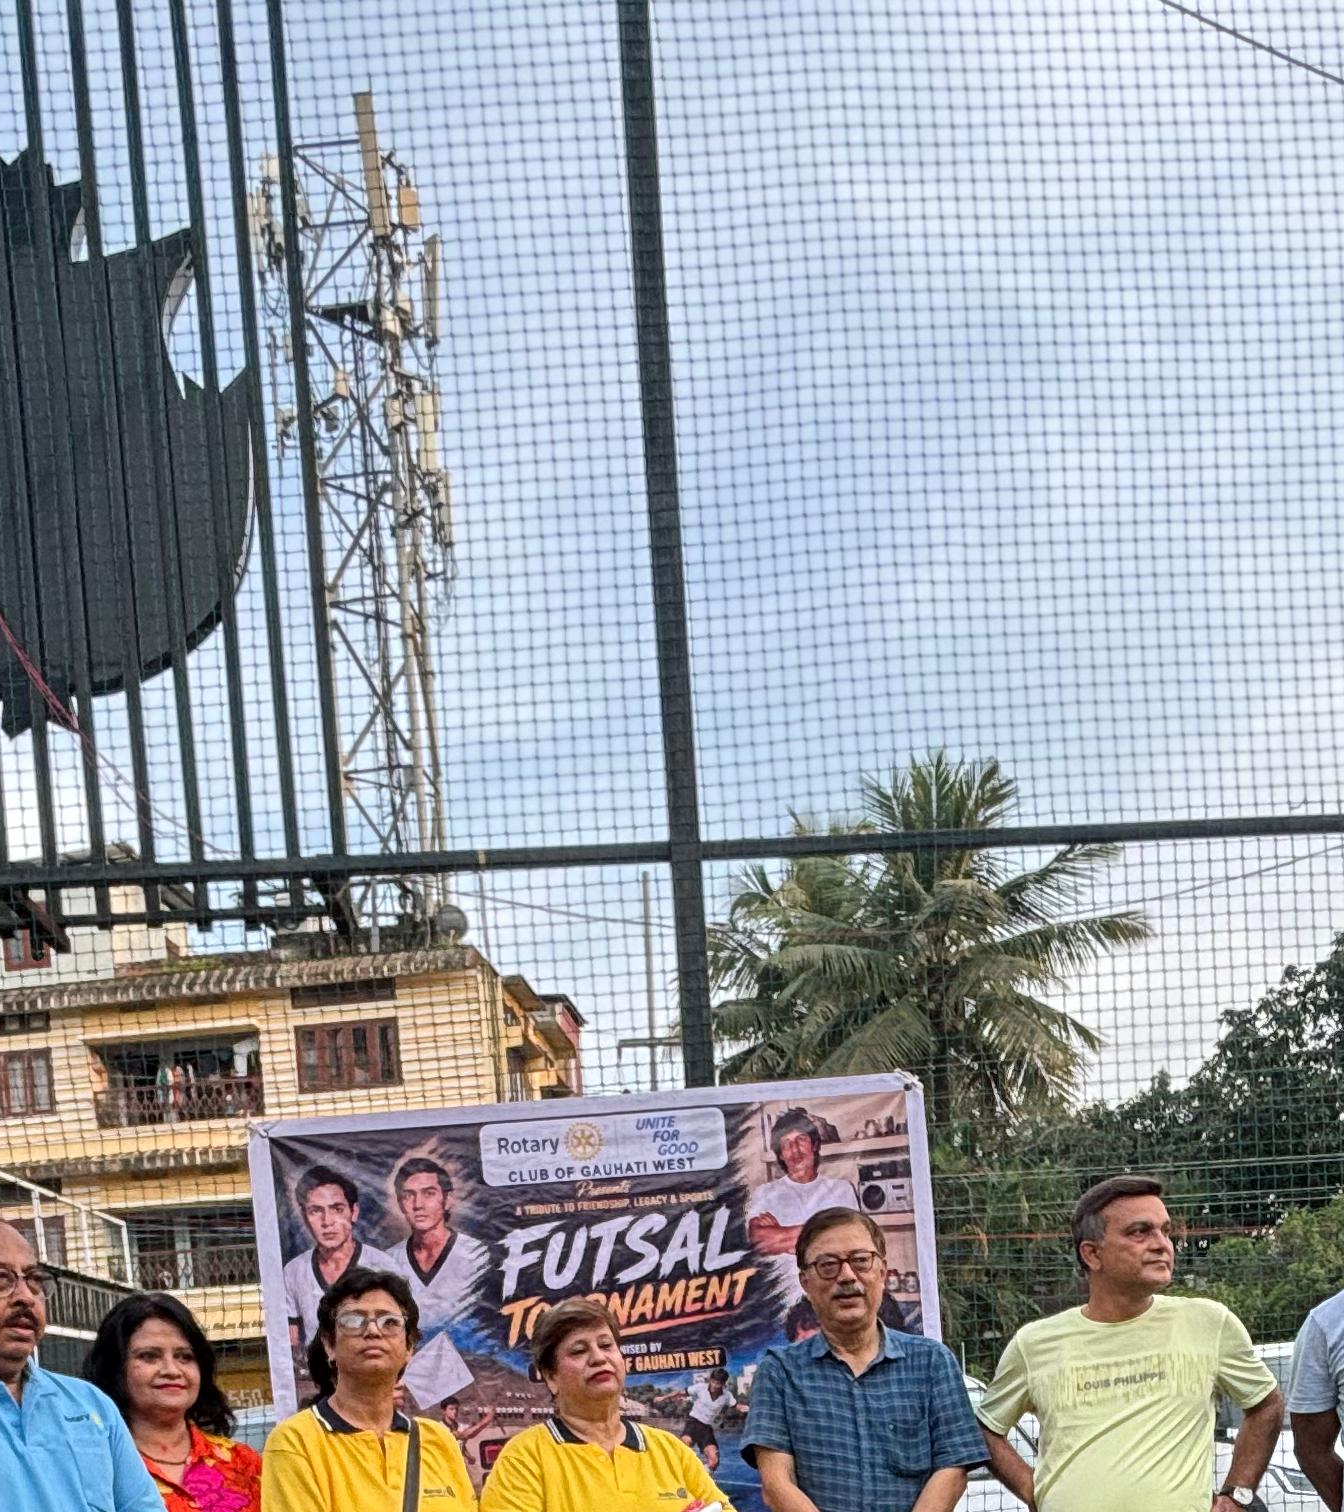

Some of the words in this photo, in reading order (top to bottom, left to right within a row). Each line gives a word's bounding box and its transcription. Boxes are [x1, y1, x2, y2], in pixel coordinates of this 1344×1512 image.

[636, 1116, 676, 1130] UNITE
[497, 1137, 560, 1155] Rotary
[653, 1129, 680, 1143] FOR
[658, 1141, 698, 1156] GOOD
[508, 1168, 550, 1182] CLUB
[555, 1166, 575, 1179] OF
[580, 1160, 648, 1177] GAUHATI
[652, 1157, 696, 1172] WEST
[515, 1206, 522, 1216] A
[523, 1203, 561, 1216] TRIBUTE
[564, 1202, 576, 1212] TO
[634, 1194, 667, 1207] LEGACY
[679, 1189, 715, 1203] SPORTS
[496, 1204, 753, 1301] FUTSAL
[498, 1268, 759, 1347] TONAMENT
[649, 1342, 662, 1353] BY
[636, 1352, 686, 1372] GAUHATI
[688, 1349, 721, 1367] WEST
[1077, 1379, 1111, 1392] LOUIS
[1113, 1371, 1167, 1387] PHILIPPE
